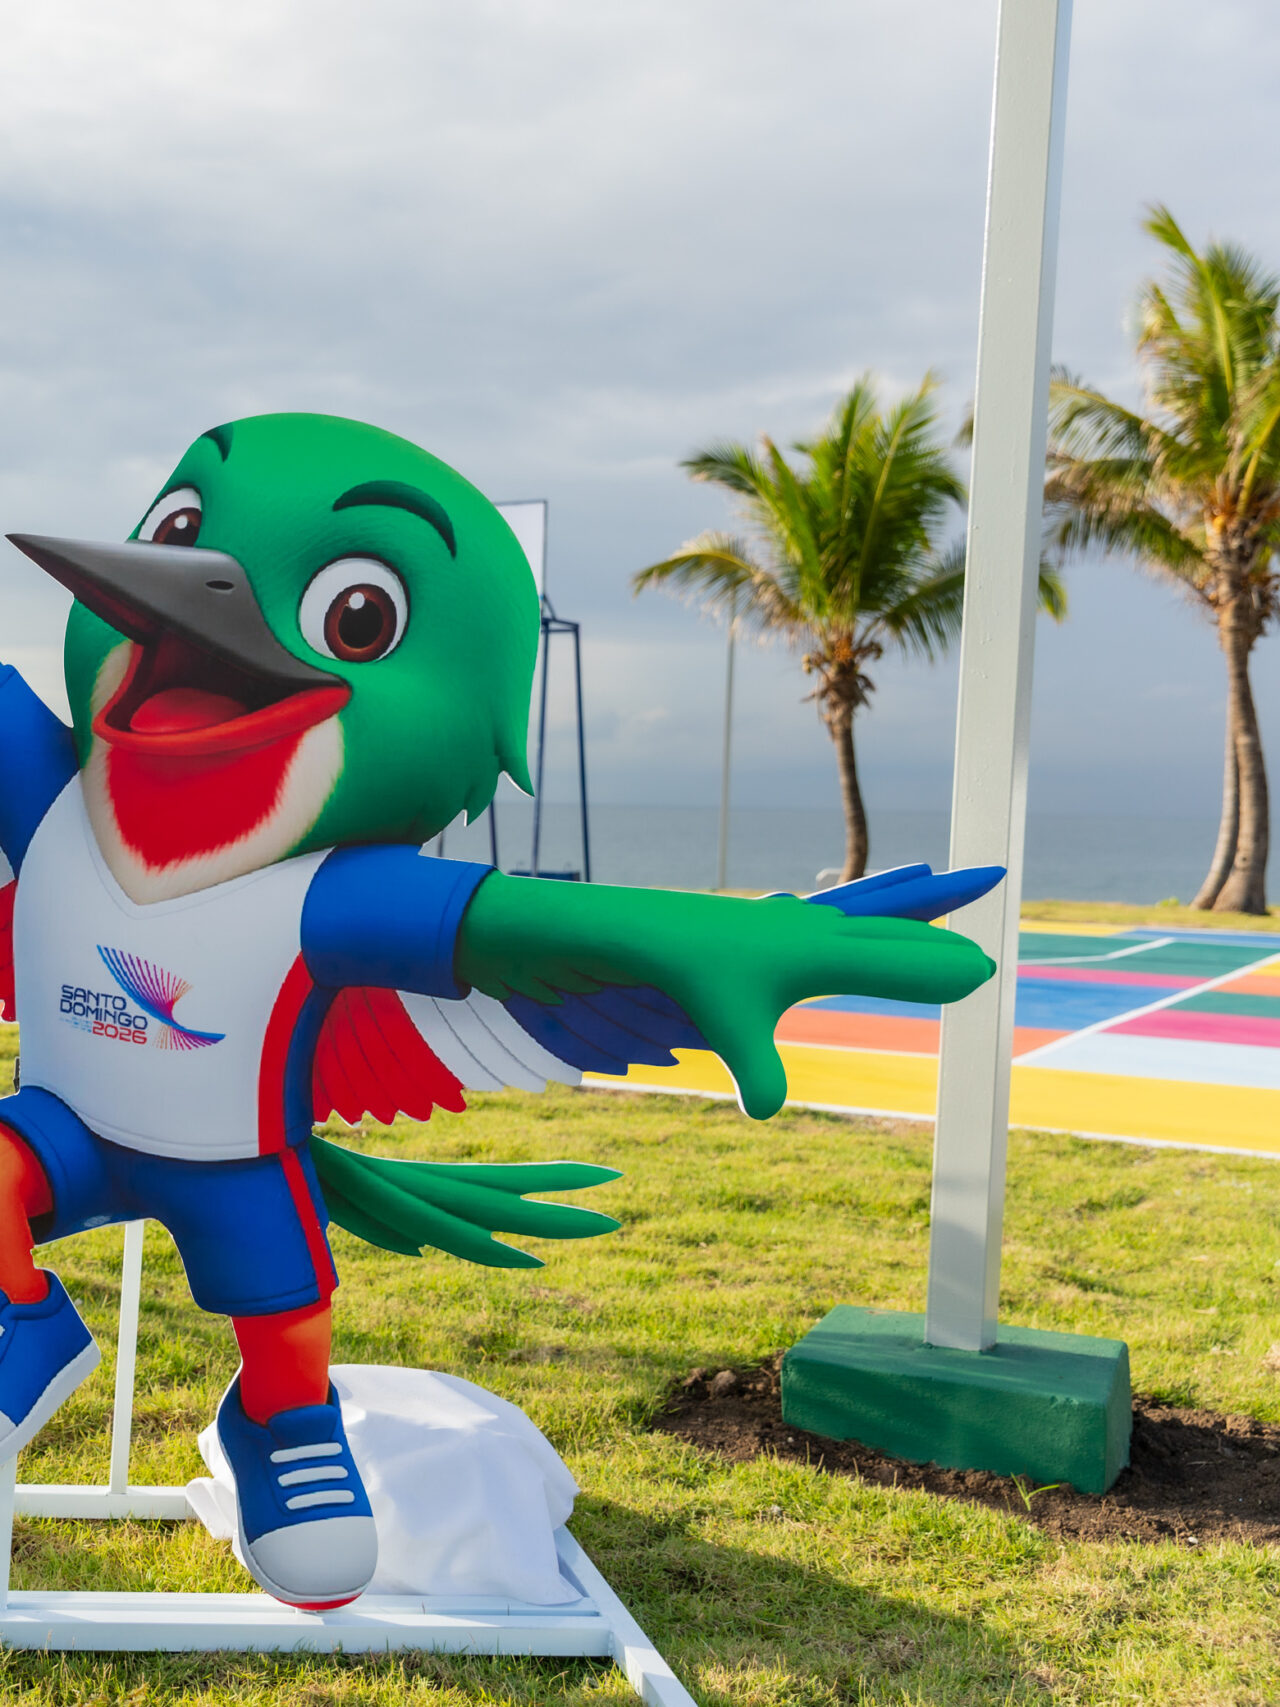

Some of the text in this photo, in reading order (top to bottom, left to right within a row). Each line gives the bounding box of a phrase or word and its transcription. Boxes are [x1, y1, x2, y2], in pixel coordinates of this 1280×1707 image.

[61, 984, 127, 1011] SANTO
[60, 999, 148, 1030] DOMINGO
[92, 1021, 148, 1045] 2026
